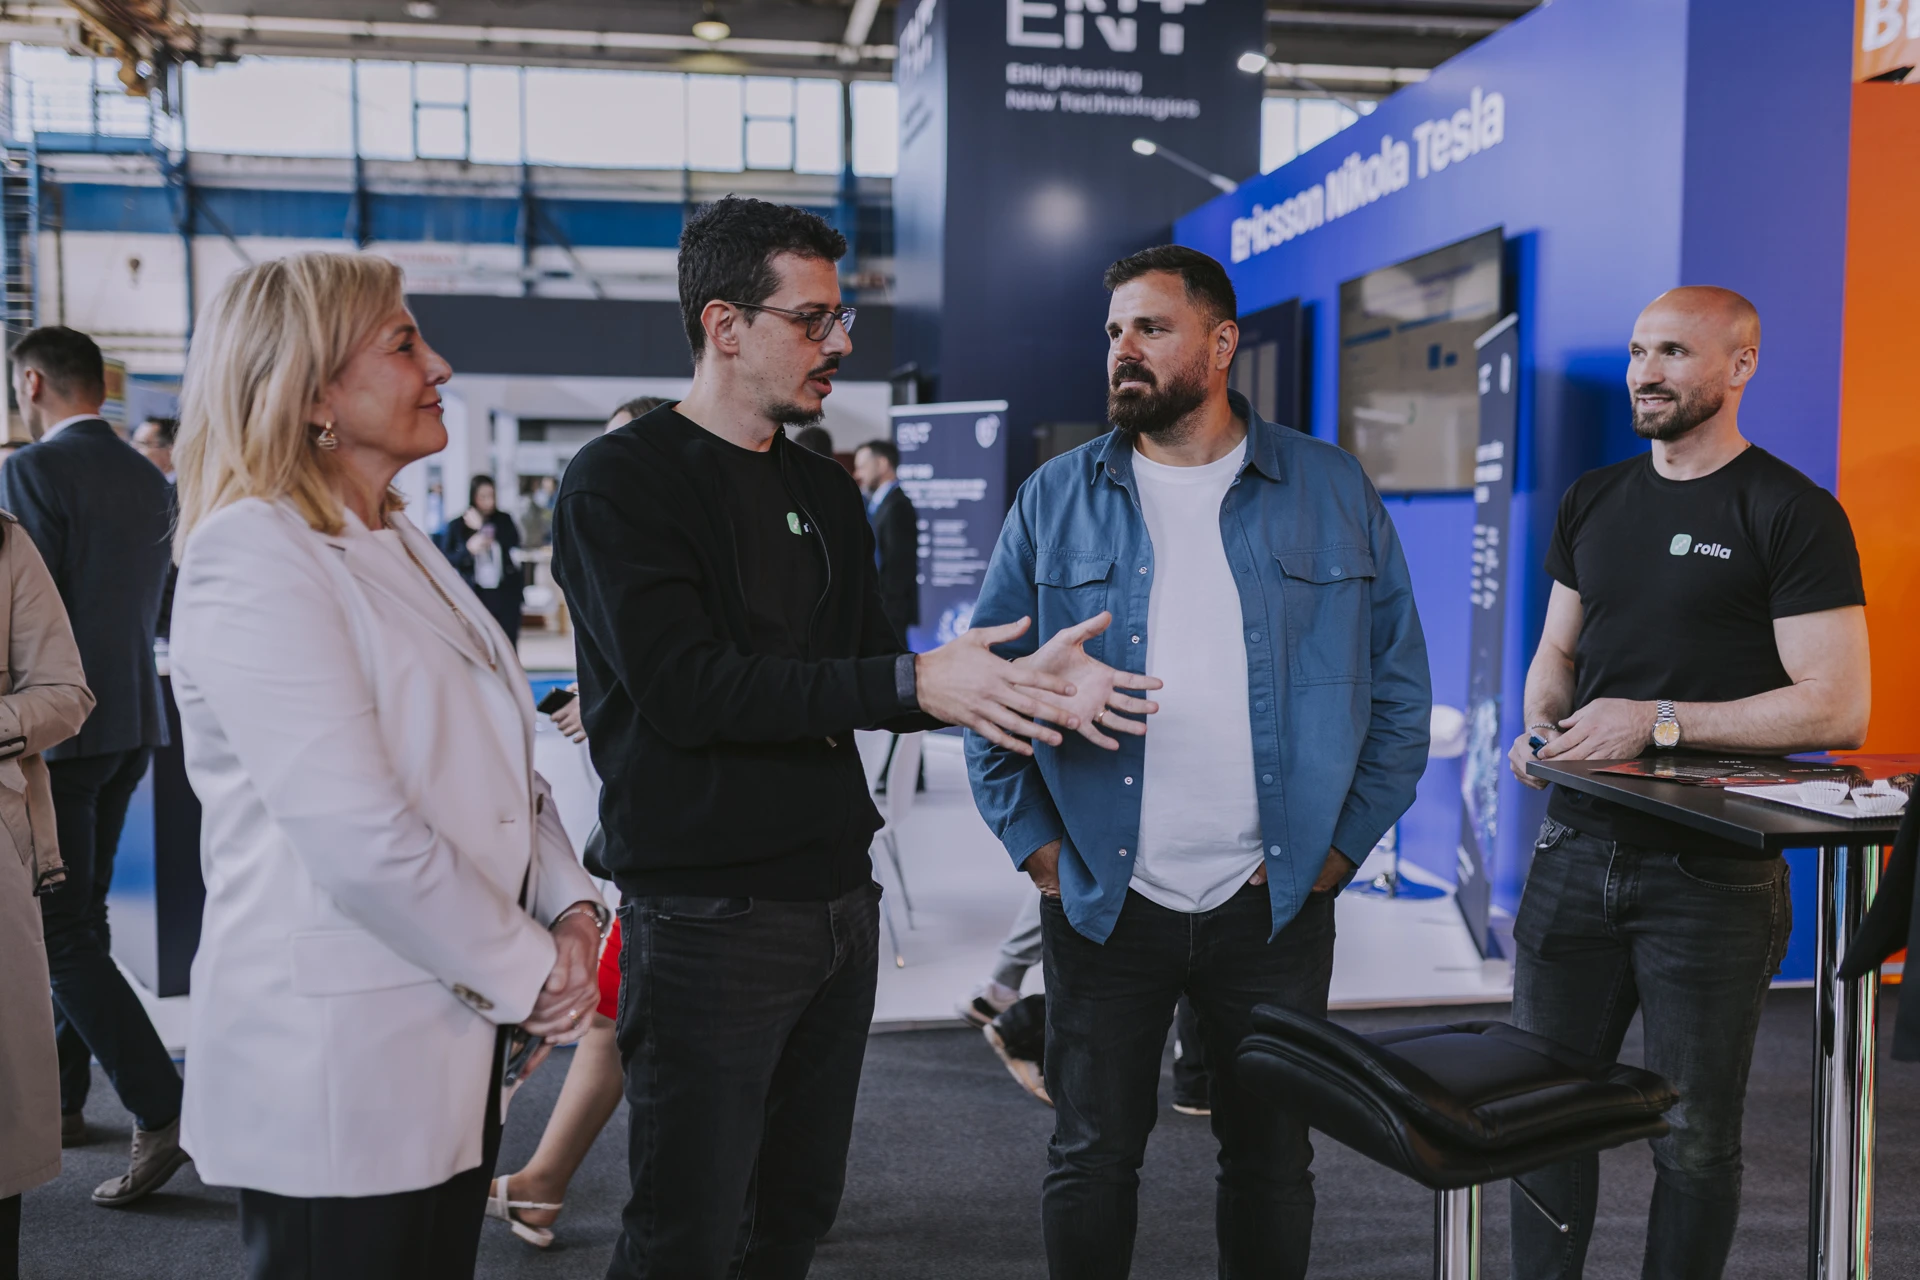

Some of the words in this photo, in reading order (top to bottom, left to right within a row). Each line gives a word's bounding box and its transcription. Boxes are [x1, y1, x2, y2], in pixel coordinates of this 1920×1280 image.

[1005, 62, 1143, 95] Enlightening
[1005, 88, 1057, 112] New
[1060, 91, 1201, 121] Technologies
[1231, 183, 1325, 264] Ericsson
[1325, 135, 1410, 222] Nikola
[1412, 86, 1505, 179] Tesla
[1693, 543, 1732, 560] rolla
